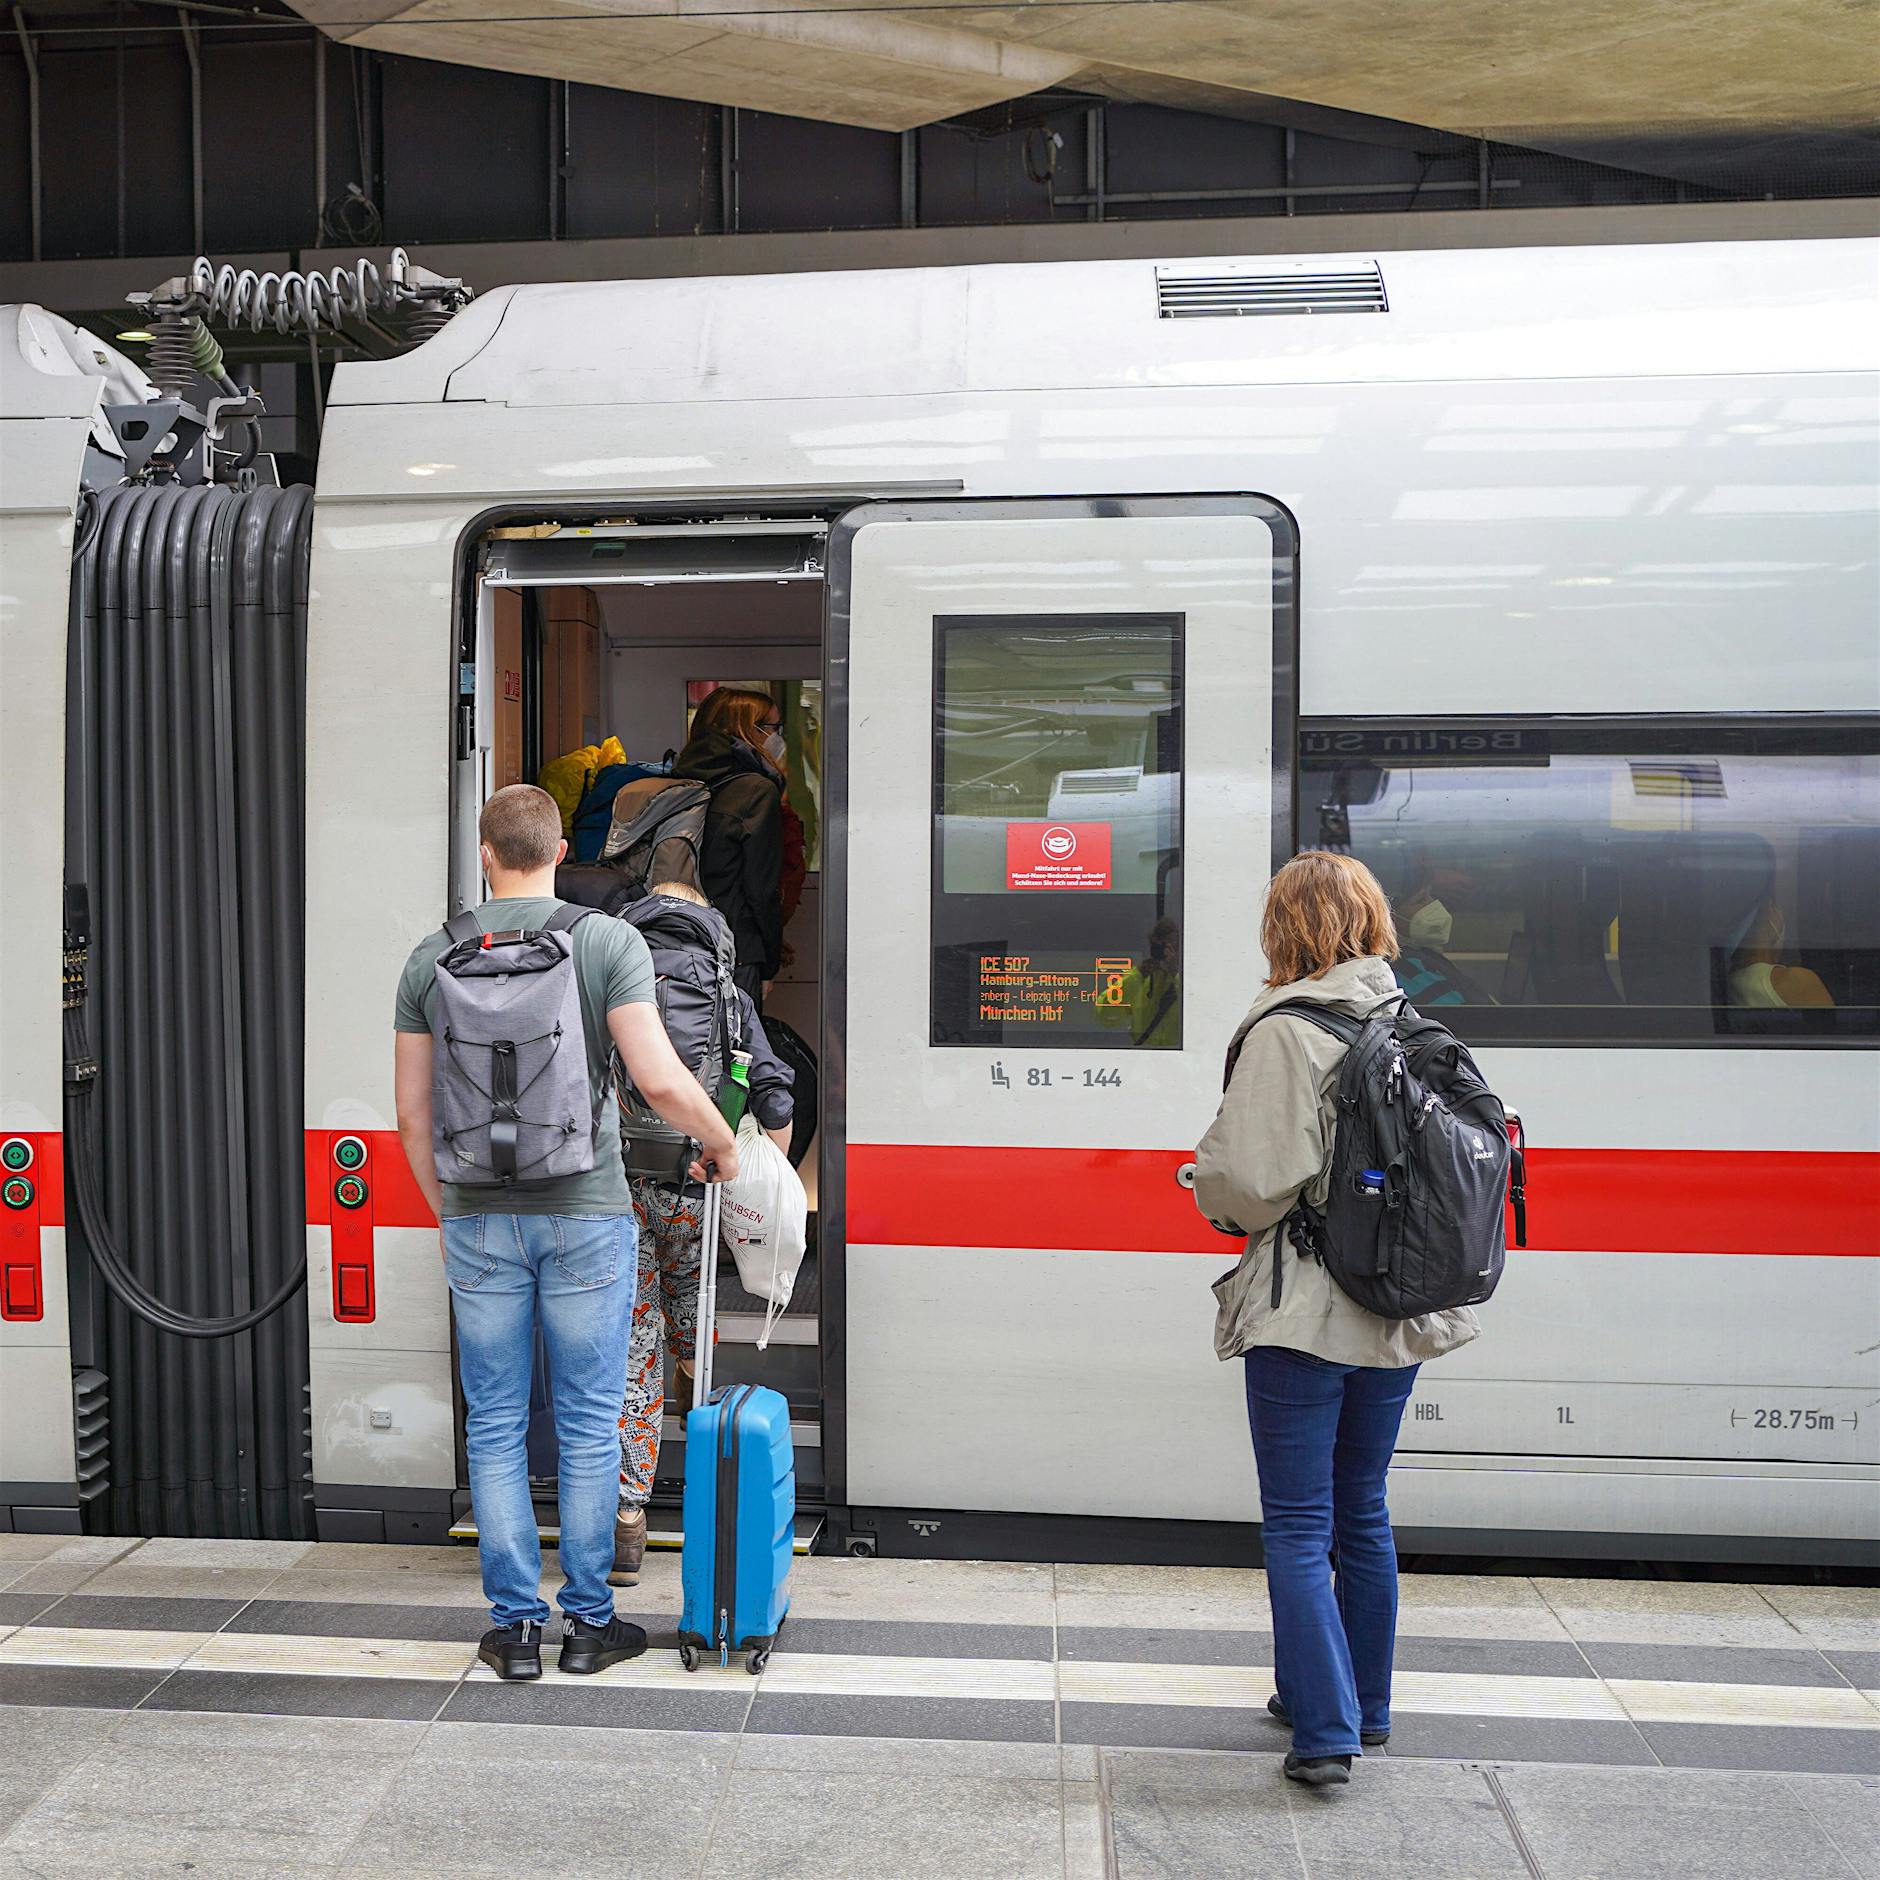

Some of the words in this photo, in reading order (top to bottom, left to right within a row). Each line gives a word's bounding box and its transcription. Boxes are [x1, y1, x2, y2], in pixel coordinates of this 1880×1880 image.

[980, 957, 1001, 972] ICE
[1004, 957, 1030, 972] 507
[980, 974, 1080, 988] Hamburg-Altona
[1106, 974, 1123, 1005] 8
[1020, 990, 1051, 1004] Leipzig
[1053, 990, 1070, 1002] Hbf
[980, 1005, 1037, 1021] München
[1040, 1005, 1064, 1021] Hbf
[1027, 1067, 1052, 1087] 81
[1083, 1068, 1122, 1087] 144
[1415, 1403, 1444, 1421] HBL
[1556, 1406, 1575, 1424] 1L
[1753, 1409, 1834, 1430] 28.75m
